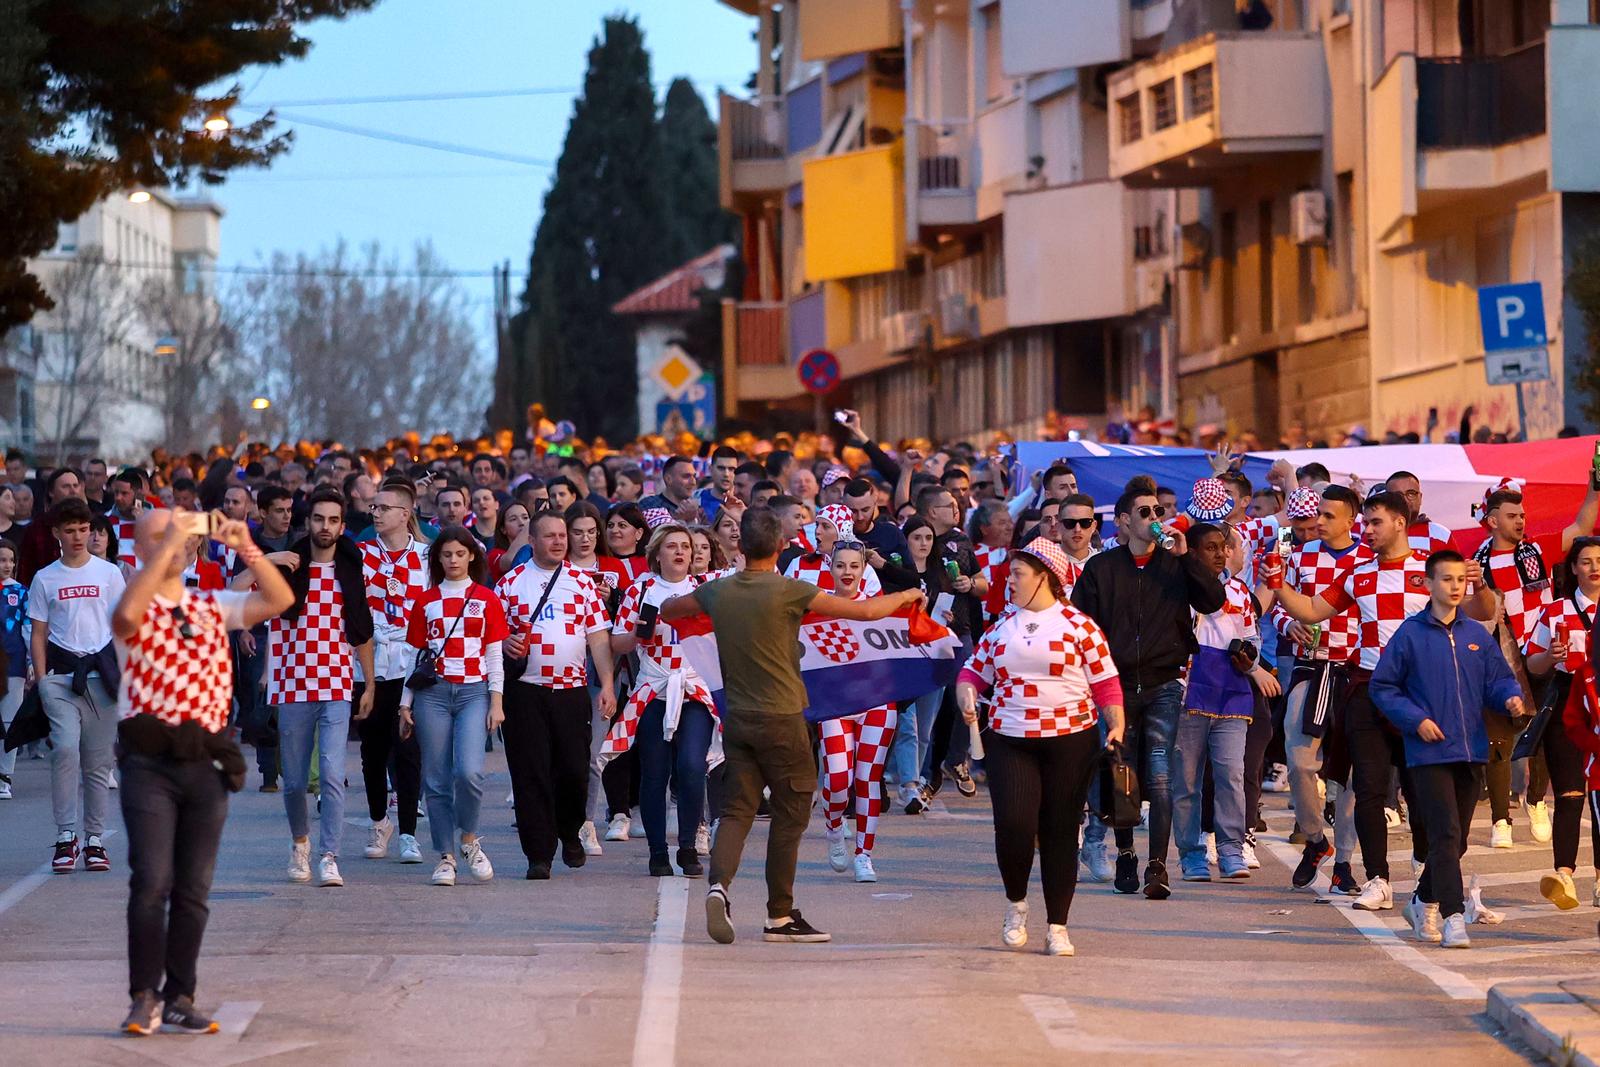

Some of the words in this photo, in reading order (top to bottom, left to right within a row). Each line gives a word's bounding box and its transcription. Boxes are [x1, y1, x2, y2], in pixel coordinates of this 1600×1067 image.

[1496, 296, 1525, 338] P
[1187, 502, 1233, 520] HRVATSKA
[430, 621, 440, 638] 6
